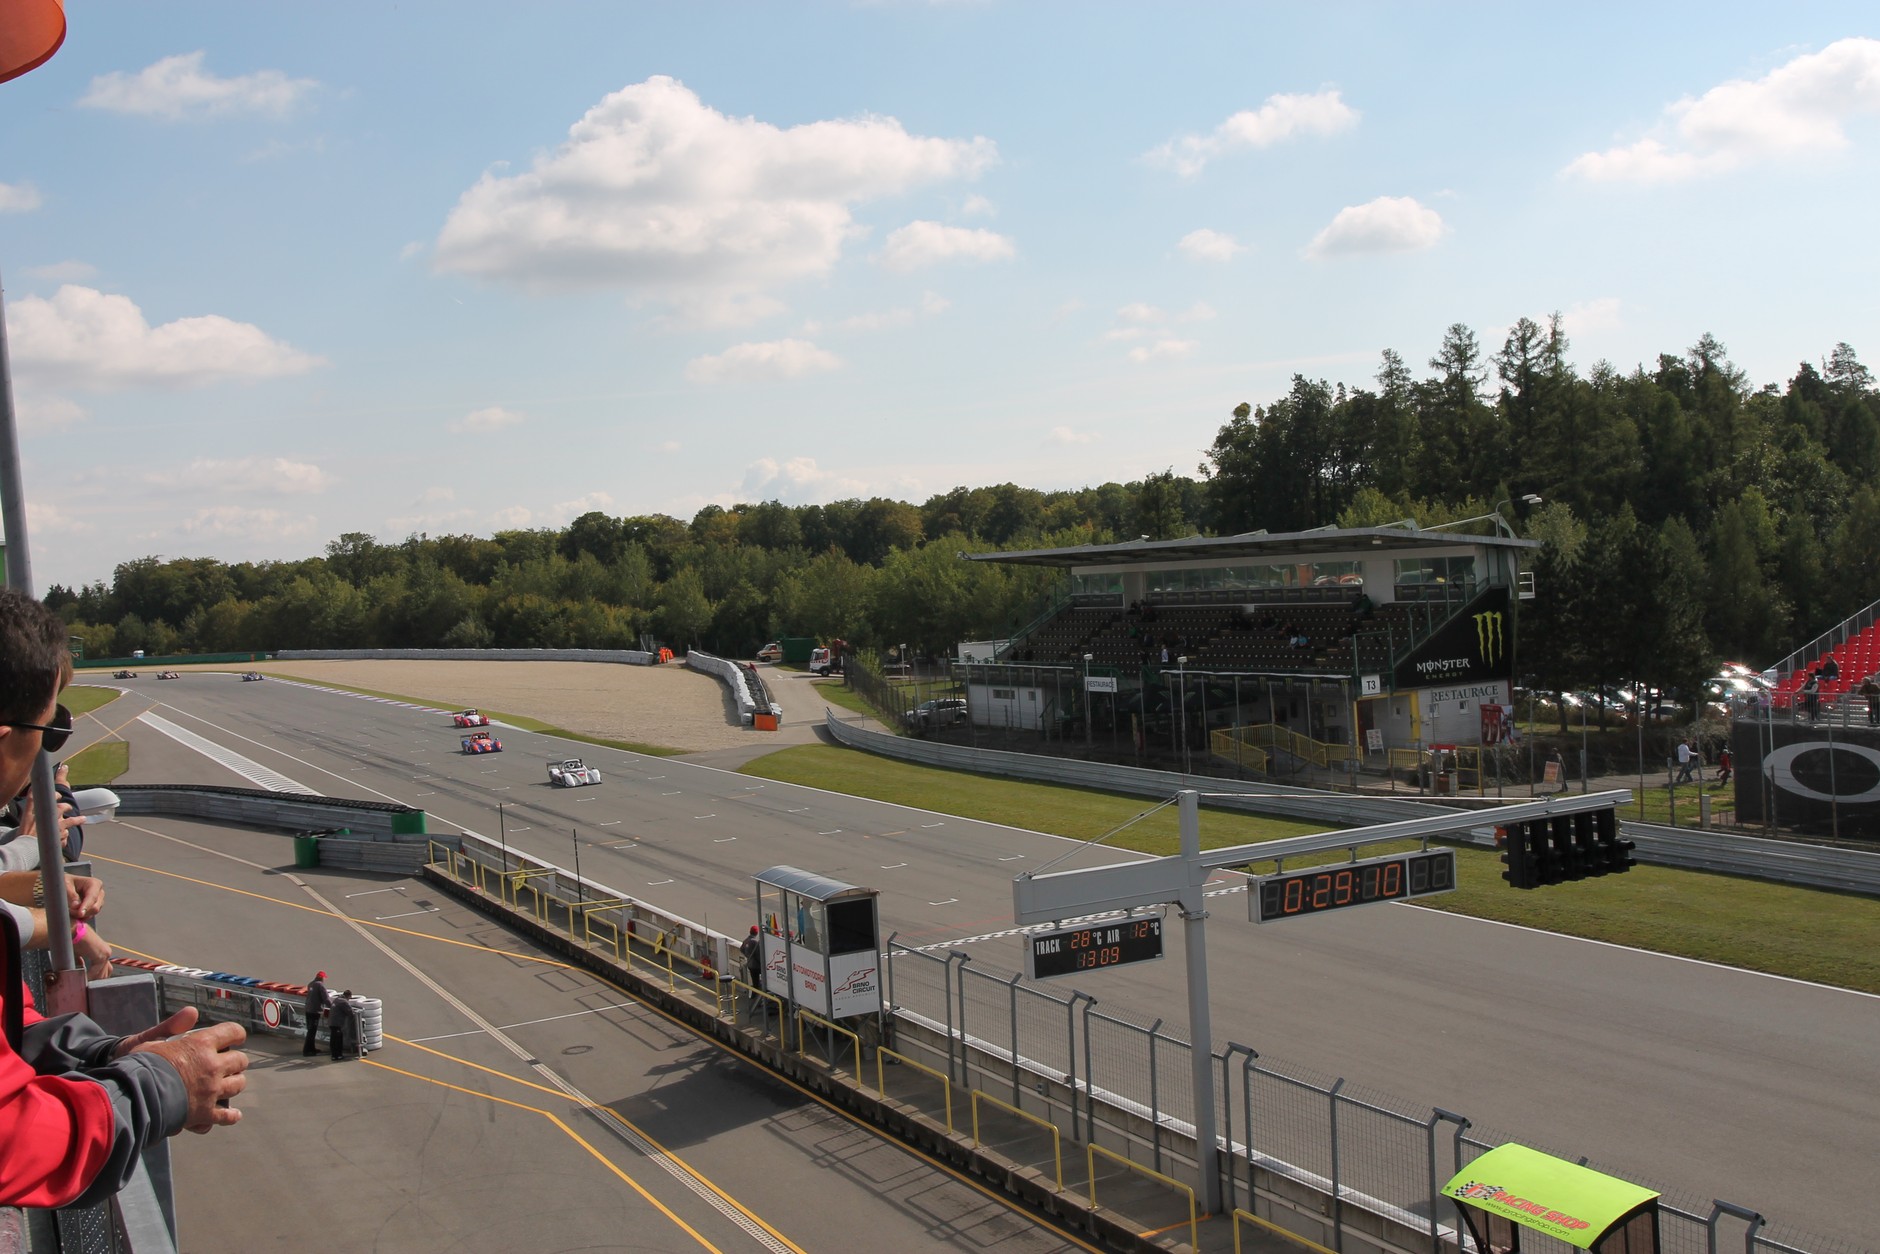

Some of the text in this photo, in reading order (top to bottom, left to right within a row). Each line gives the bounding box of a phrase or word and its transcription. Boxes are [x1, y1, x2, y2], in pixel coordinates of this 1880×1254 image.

[1416, 658, 1471, 673] MONSTER
[1425, 671, 1463, 680] ENERGY
[1086, 680, 1115, 688] RESTAURACE
[1366, 680, 1376, 690] T3
[1431, 685, 1499, 702] RESTAURACE
[1284, 863, 1401, 913] 0:29:10
[1036, 938, 1060, 955] TRACK
[1071, 930, 1091, 949] 28
[1107, 929, 1120, 944] AIR
[1134, 921, 1149, 938] 12
[792, 963, 826, 983] AUTOMOTODRO
[804, 980, 817, 992] BRNO
[852, 981, 870, 989] BRNO
[852, 985, 875, 994] CIRCUIT
[1490, 1190, 1549, 1216] RACING
[1541, 1210, 1590, 1231] SHOP
